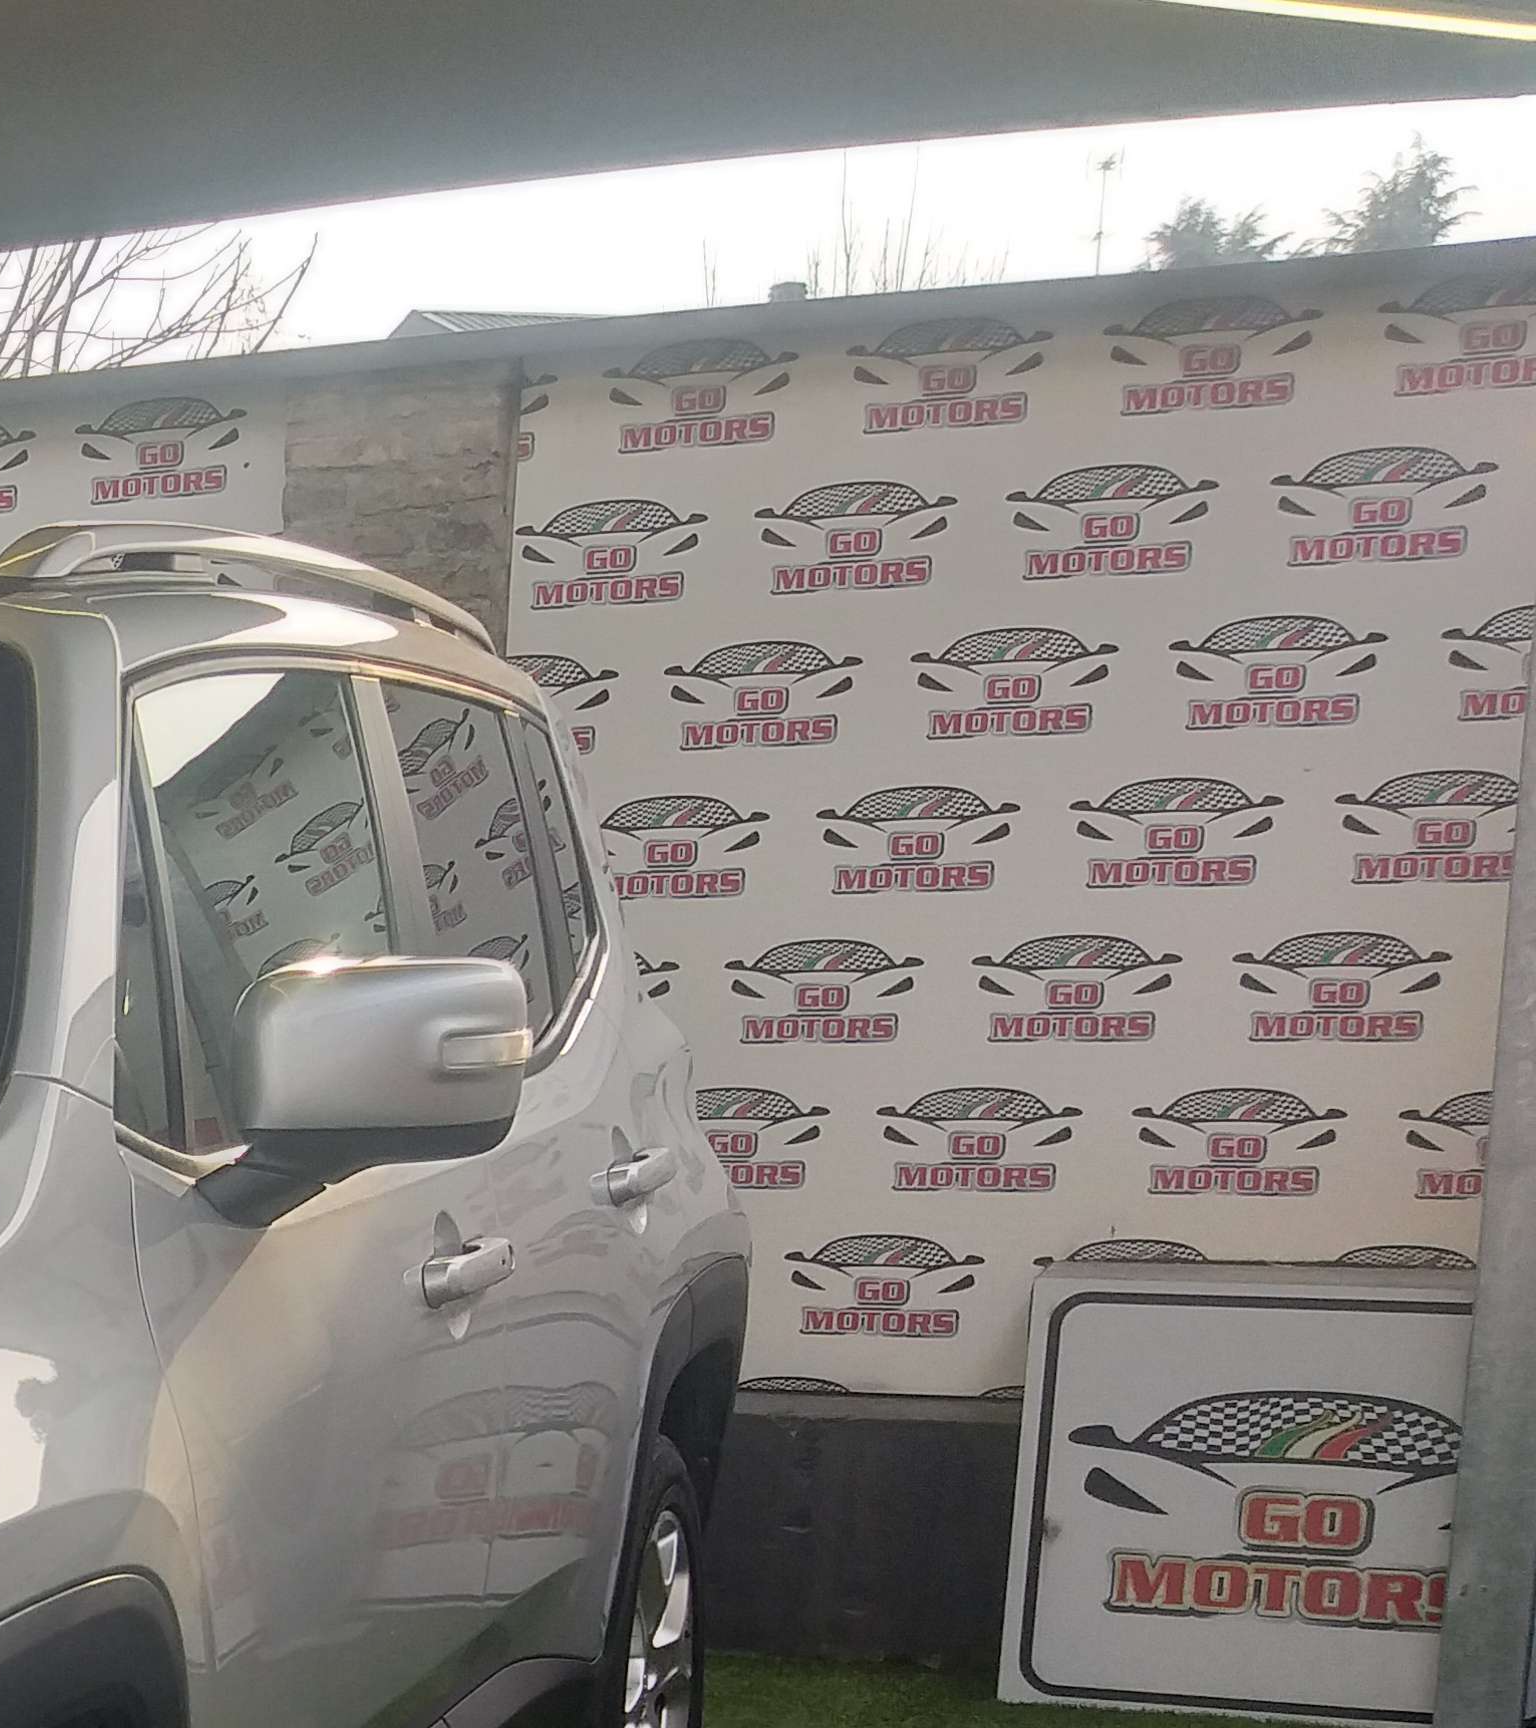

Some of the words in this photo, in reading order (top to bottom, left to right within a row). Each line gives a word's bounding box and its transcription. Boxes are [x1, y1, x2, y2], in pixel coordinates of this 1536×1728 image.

[1462, 322, 1524, 351] GO
[1181, 346, 1237, 374] GO
[1400, 357, 1536, 394] MOTO
[920, 365, 974, 392] GO
[1125, 375, 1292, 413] MOTORS
[673, 385, 723, 412] GO
[867, 395, 1024, 432] MOTORS
[621, 415, 772, 452] MOTORS
[138, 441, 183, 467] GO
[94, 466, 224, 503] MOTORS
[1079, 512, 1139, 543] GO
[1351, 498, 1411, 528] GO
[826, 527, 882, 558] GO
[1293, 527, 1464, 565] MOTORS
[582, 543, 636, 575] GO
[1028, 542, 1189, 579] MOTORS
[533, 572, 681, 609] MOTORS
[776, 557, 931, 594] MOTORS
[983, 674, 1040, 704] GO
[1246, 664, 1305, 694] GO
[734, 684, 788, 716] GO
[1189, 694, 1359, 726] MOTORS
[683, 715, 837, 748] MOTORS
[931, 704, 1090, 737] MOTORS
[887, 830, 943, 860] GO
[1144, 823, 1203, 854] GO
[1413, 817, 1474, 848] GO
[643, 838, 697, 868] GO
[836, 862, 994, 893] MOTORS
[1090, 855, 1255, 888] MOTORS
[795, 983, 849, 1013] GO
[1045, 980, 1103, 1010] GO
[1309, 978, 1370, 1008] GO
[743, 1014, 897, 1044] MOTORS
[991, 1012, 1154, 1043] MOTORS
[1254, 1011, 1422, 1042] MOTORS
[707, 1131, 755, 1156] GO
[950, 1131, 1006, 1159] GO
[1207, 1133, 1265, 1163] GO
[727, 1162, 802, 1187] ORS
[897, 1162, 1054, 1191] MOTORS
[1153, 1165, 1318, 1197] MOTORS
[854, 1276, 908, 1305] GO
[803, 1307, 957, 1338] MOTORS
[1239, 1494, 1368, 1550] GO
[1113, 1555, 1447, 1625] MOTOR
